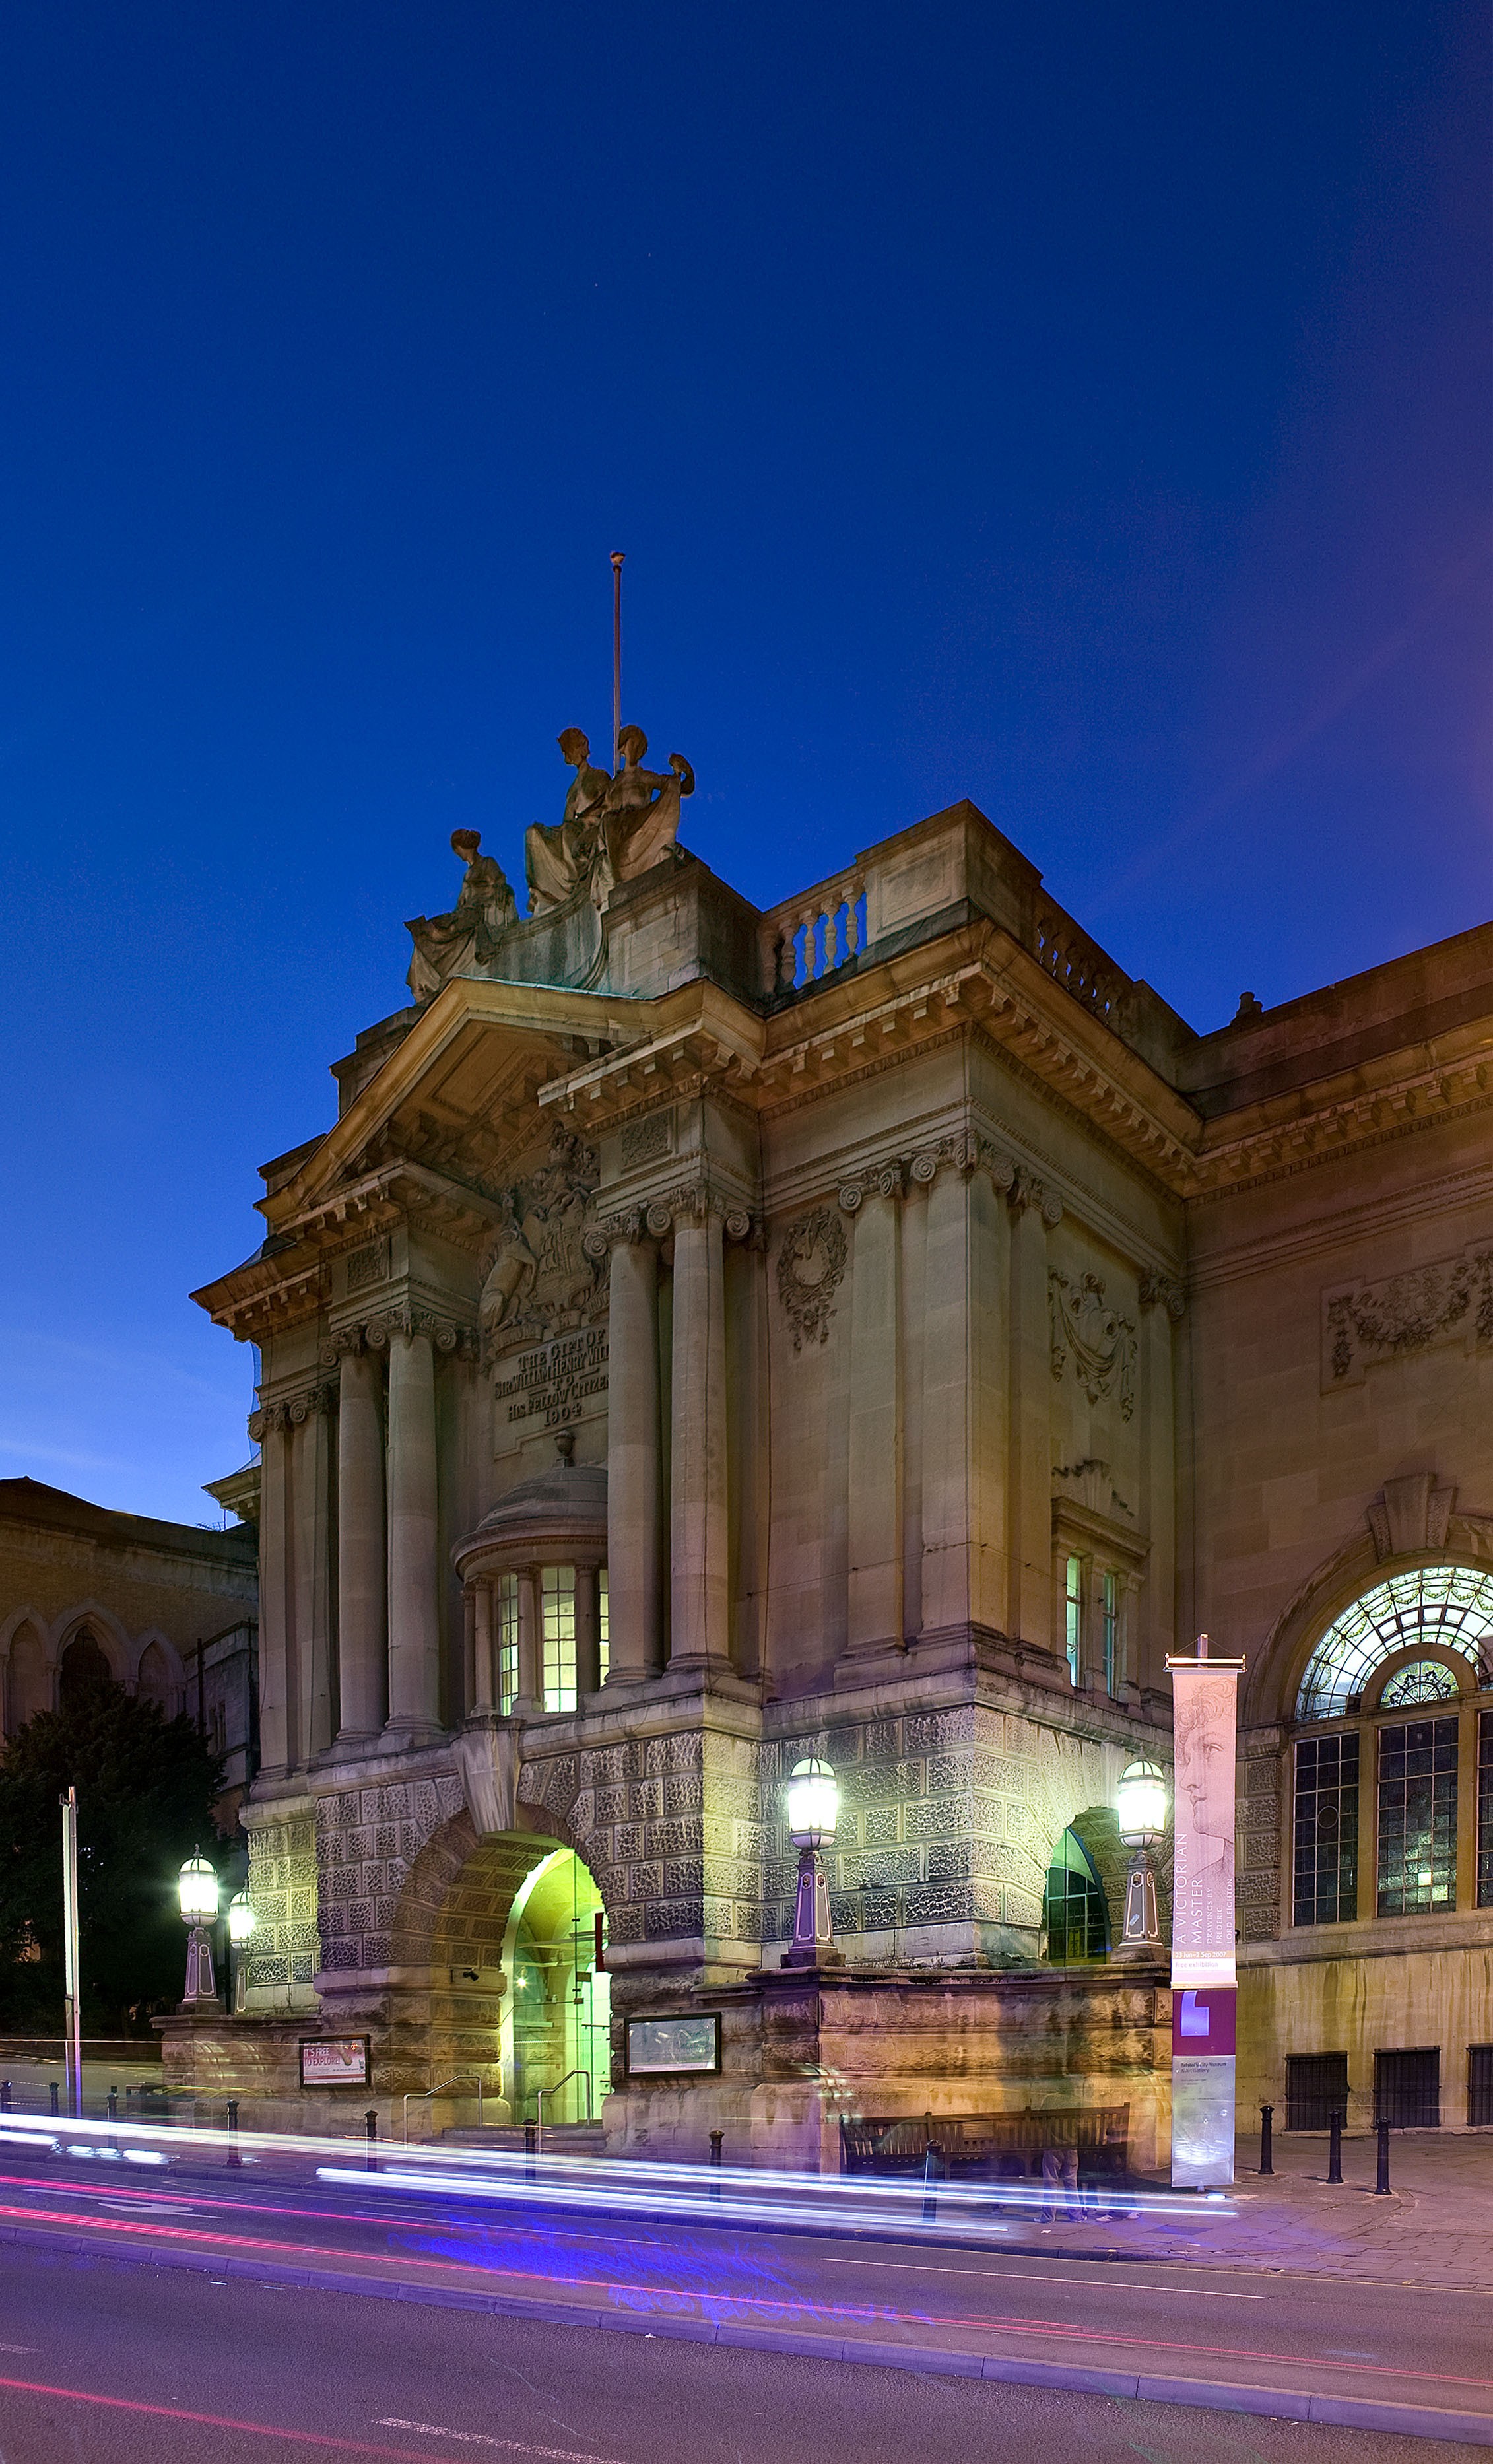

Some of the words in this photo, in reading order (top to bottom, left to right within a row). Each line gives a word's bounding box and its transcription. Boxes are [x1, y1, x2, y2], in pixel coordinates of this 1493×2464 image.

[519, 1352, 547, 1372] THE
[551, 1337, 583, 1360] GIFT
[587, 1329, 605, 1347] OF
[495, 1380, 512, 1399] SIR
[512, 1365, 551, 1393] WILLIAM
[551, 1352, 587, 1380] HENRY
[552, 1375, 574, 1391] TO
[508, 1404, 526, 1422] HIS
[529, 1387, 570, 1416] FELLOW
[544, 1403, 581, 1427] 1904
[1175, 1834, 1187, 1928] VICTORIAN
[1207, 1888, 1213, 1898] BY
[1191, 1879, 1203, 1944] MASTER
[1176, 1934, 1187, 1944] A
[304, 2057, 312, 2067] TO
[316, 2047, 330, 2057] FREE
